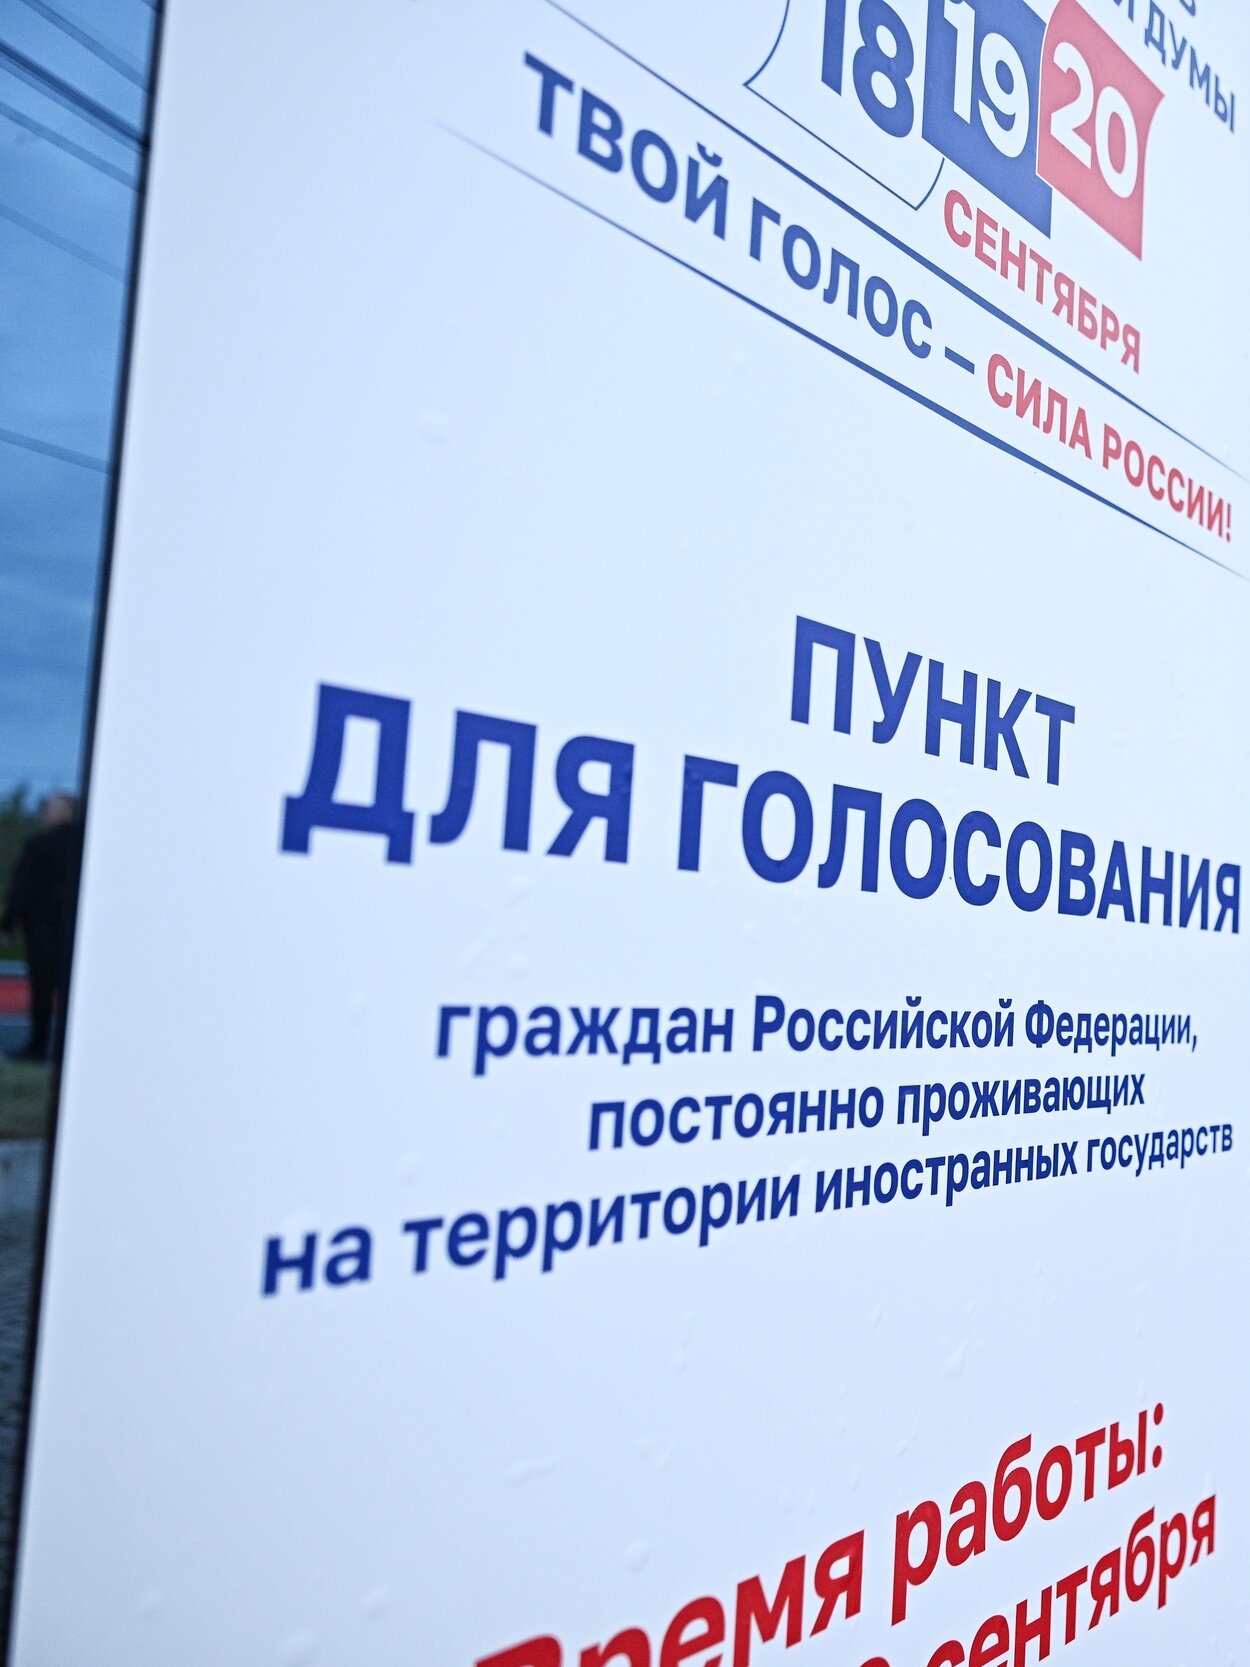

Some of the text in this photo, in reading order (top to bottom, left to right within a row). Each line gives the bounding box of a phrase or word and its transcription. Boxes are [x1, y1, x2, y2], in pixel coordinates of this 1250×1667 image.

[821, 0, 1139, 199] 18 19 20
[1143, 0, 1235, 134] ДУМЫ
[523, 50, 730, 242] ТВОЙ
[749, 196, 933, 361] ГОЛОС
[987, 353, 1094, 460] СИЛА
[1102, 423, 1233, 543] РОССИИ!
[943, 189, 1141, 374] СЕНТЯБРЯ
[790, 614, 1076, 787] ПУНКТ
[278, 681, 1242, 935] ДЛЯ ГОЛОСОВАНИЯ
[435, 995, 1199, 1078] граждан Российской Федерации,
[588, 1073, 1146, 1152] постоянно проживающих
[260, 1123, 1234, 1299] на территории иностранных государств
[891, 1402, 1165, 1627] работы:
